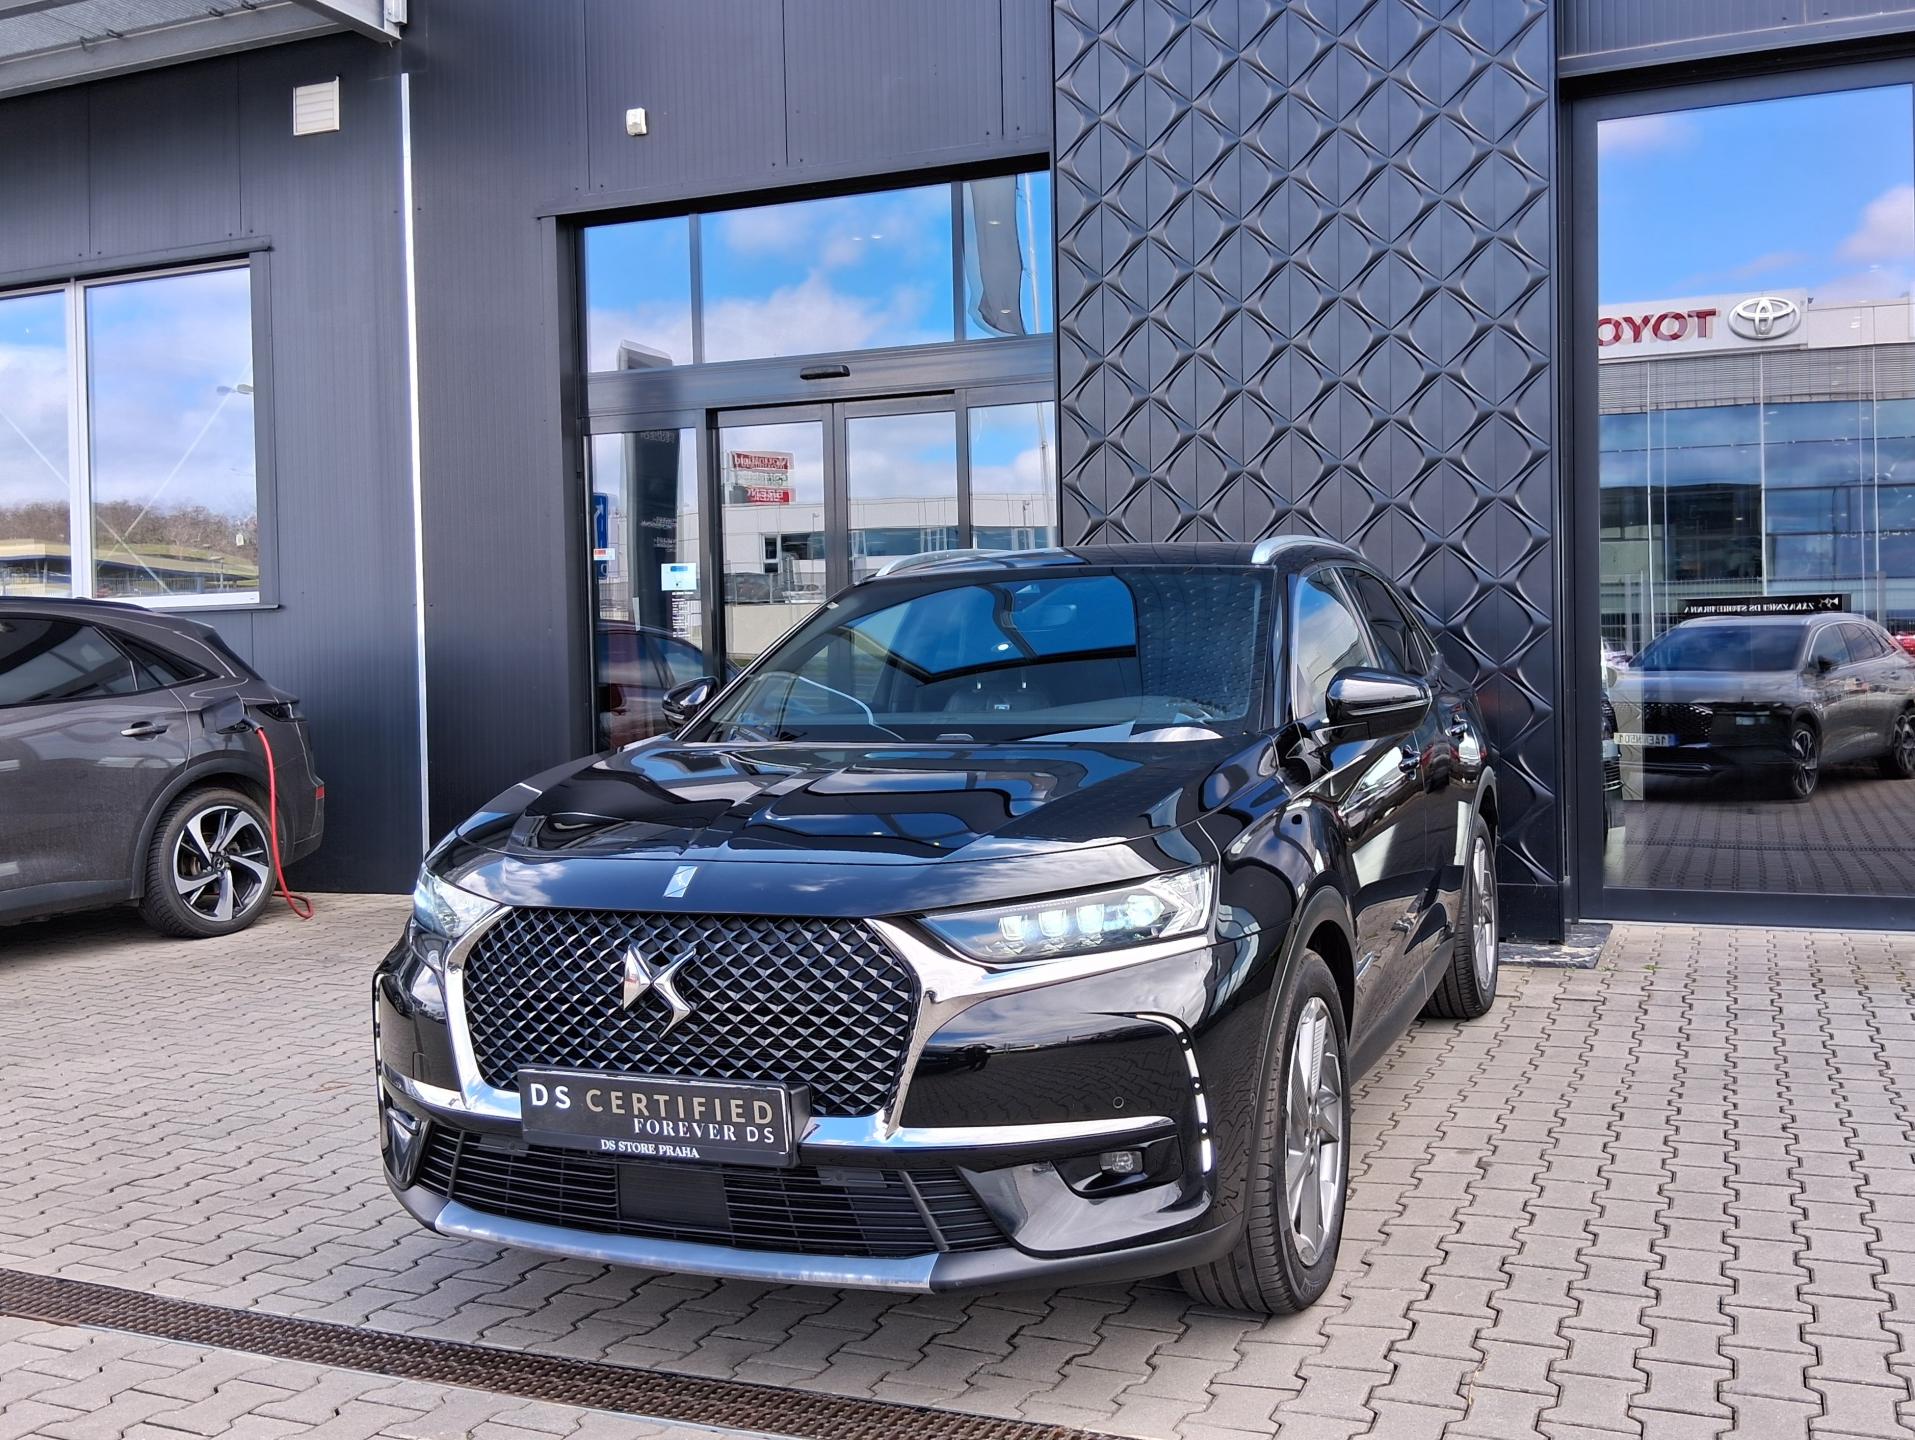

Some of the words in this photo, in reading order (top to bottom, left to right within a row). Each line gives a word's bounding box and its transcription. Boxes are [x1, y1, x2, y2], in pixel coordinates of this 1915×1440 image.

[530, 1083, 571, 1109] DS
[586, 1089, 773, 1124] CERTIFIED
[633, 1118, 737, 1141] FOREVER
[746, 1126, 775, 1143] DS
[600, 1139, 616, 1150] DS
[618, 1141, 656, 1154] STORE
[658, 1146, 700, 1158] PRAHA
